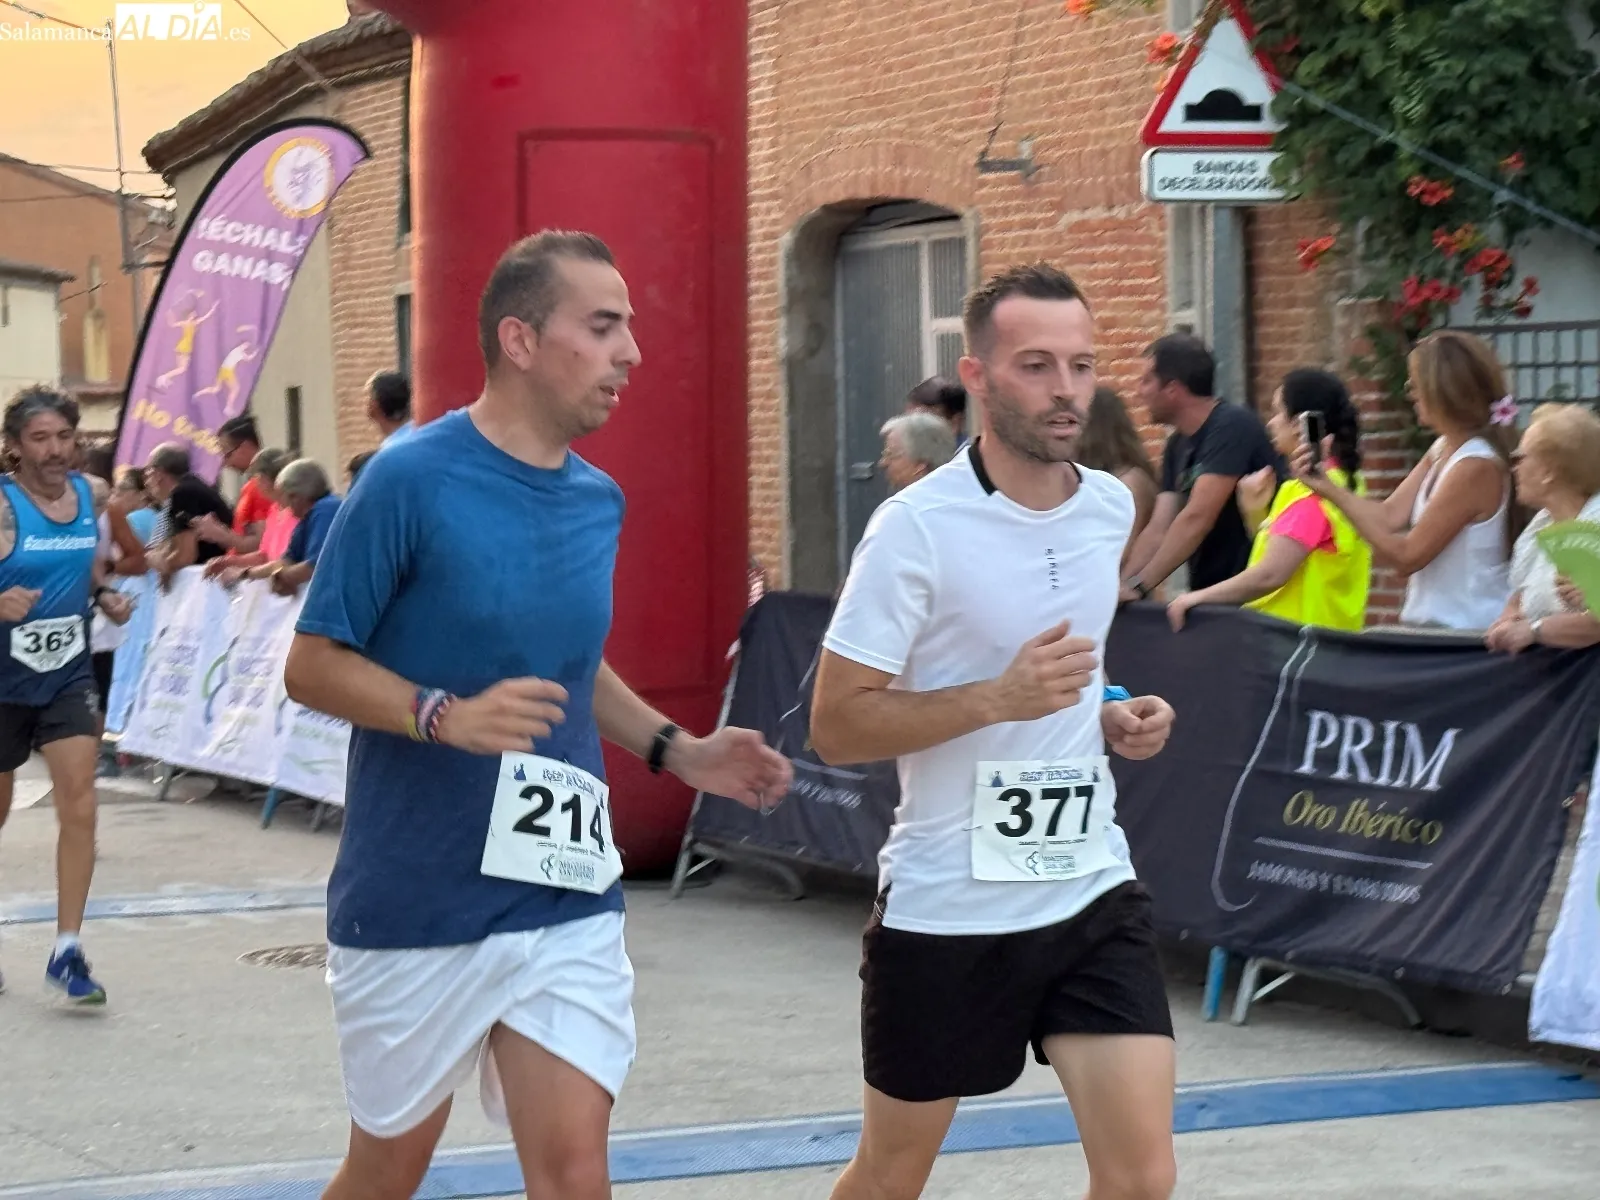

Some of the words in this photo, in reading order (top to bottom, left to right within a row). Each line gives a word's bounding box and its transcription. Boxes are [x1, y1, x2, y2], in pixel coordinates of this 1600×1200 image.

[23, 627, 76, 653] 363
[1293, 709, 1463, 791] PRIM
[512, 785, 606, 853] 214
[994, 784, 1094, 838] 377
[1282, 790, 1338, 830] Oro
[1336, 798, 1444, 845] Ibérico
